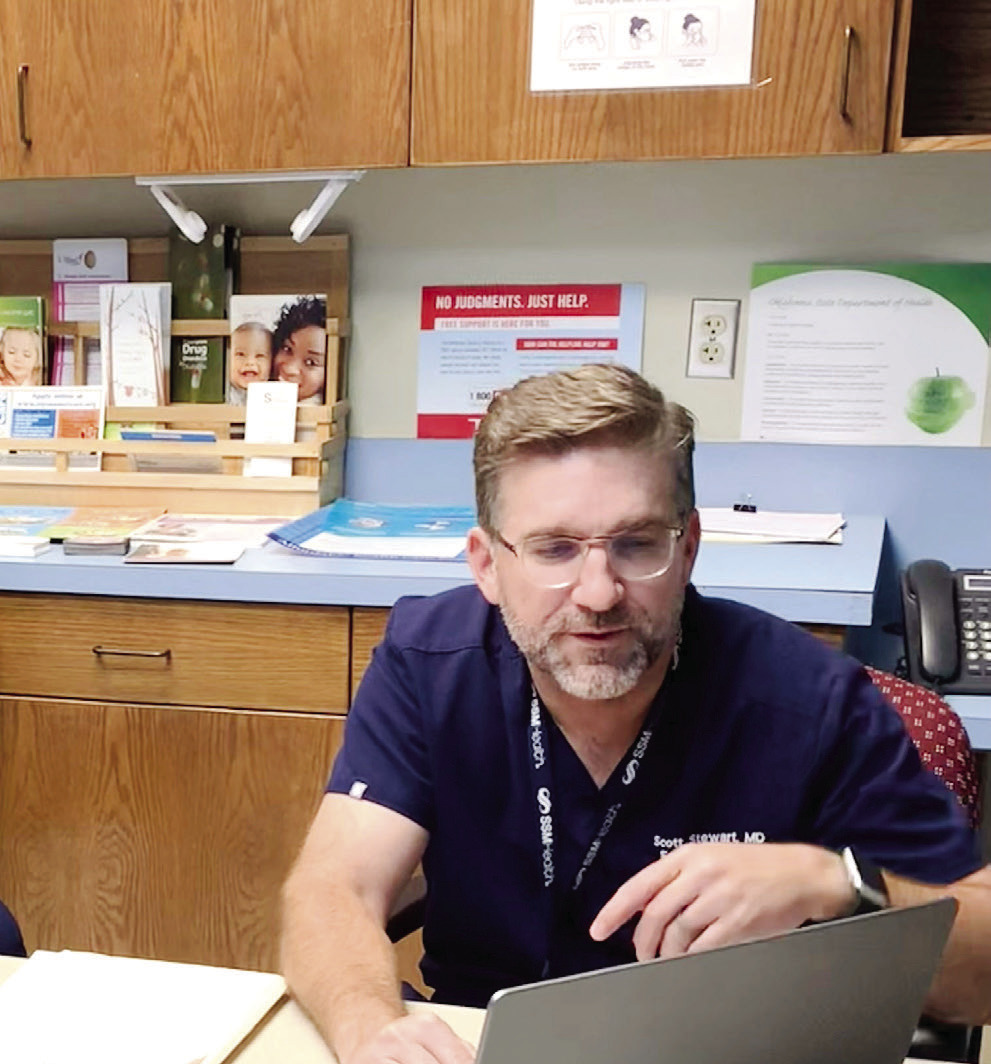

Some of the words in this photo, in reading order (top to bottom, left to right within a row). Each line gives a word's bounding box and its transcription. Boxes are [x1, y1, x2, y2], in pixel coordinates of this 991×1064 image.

[435, 295, 452, 309] NO
[454, 294, 524, 309] JUDGMENTS.
[527, 294, 555, 309] JUST
[558, 294, 589, 309] HELP.
[768, 297, 812, 310] Oklahoma
[815, 298, 835, 307] State
[837, 298, 890, 310] Department
[441, 320, 457, 329] FREE
[459, 320, 491, 328] SUPPORT
[519, 319, 534, 328] FOR
[182, 342, 208, 357] Drug
[653, 835, 684, 847] Scott
[744, 831, 766, 844] MD
